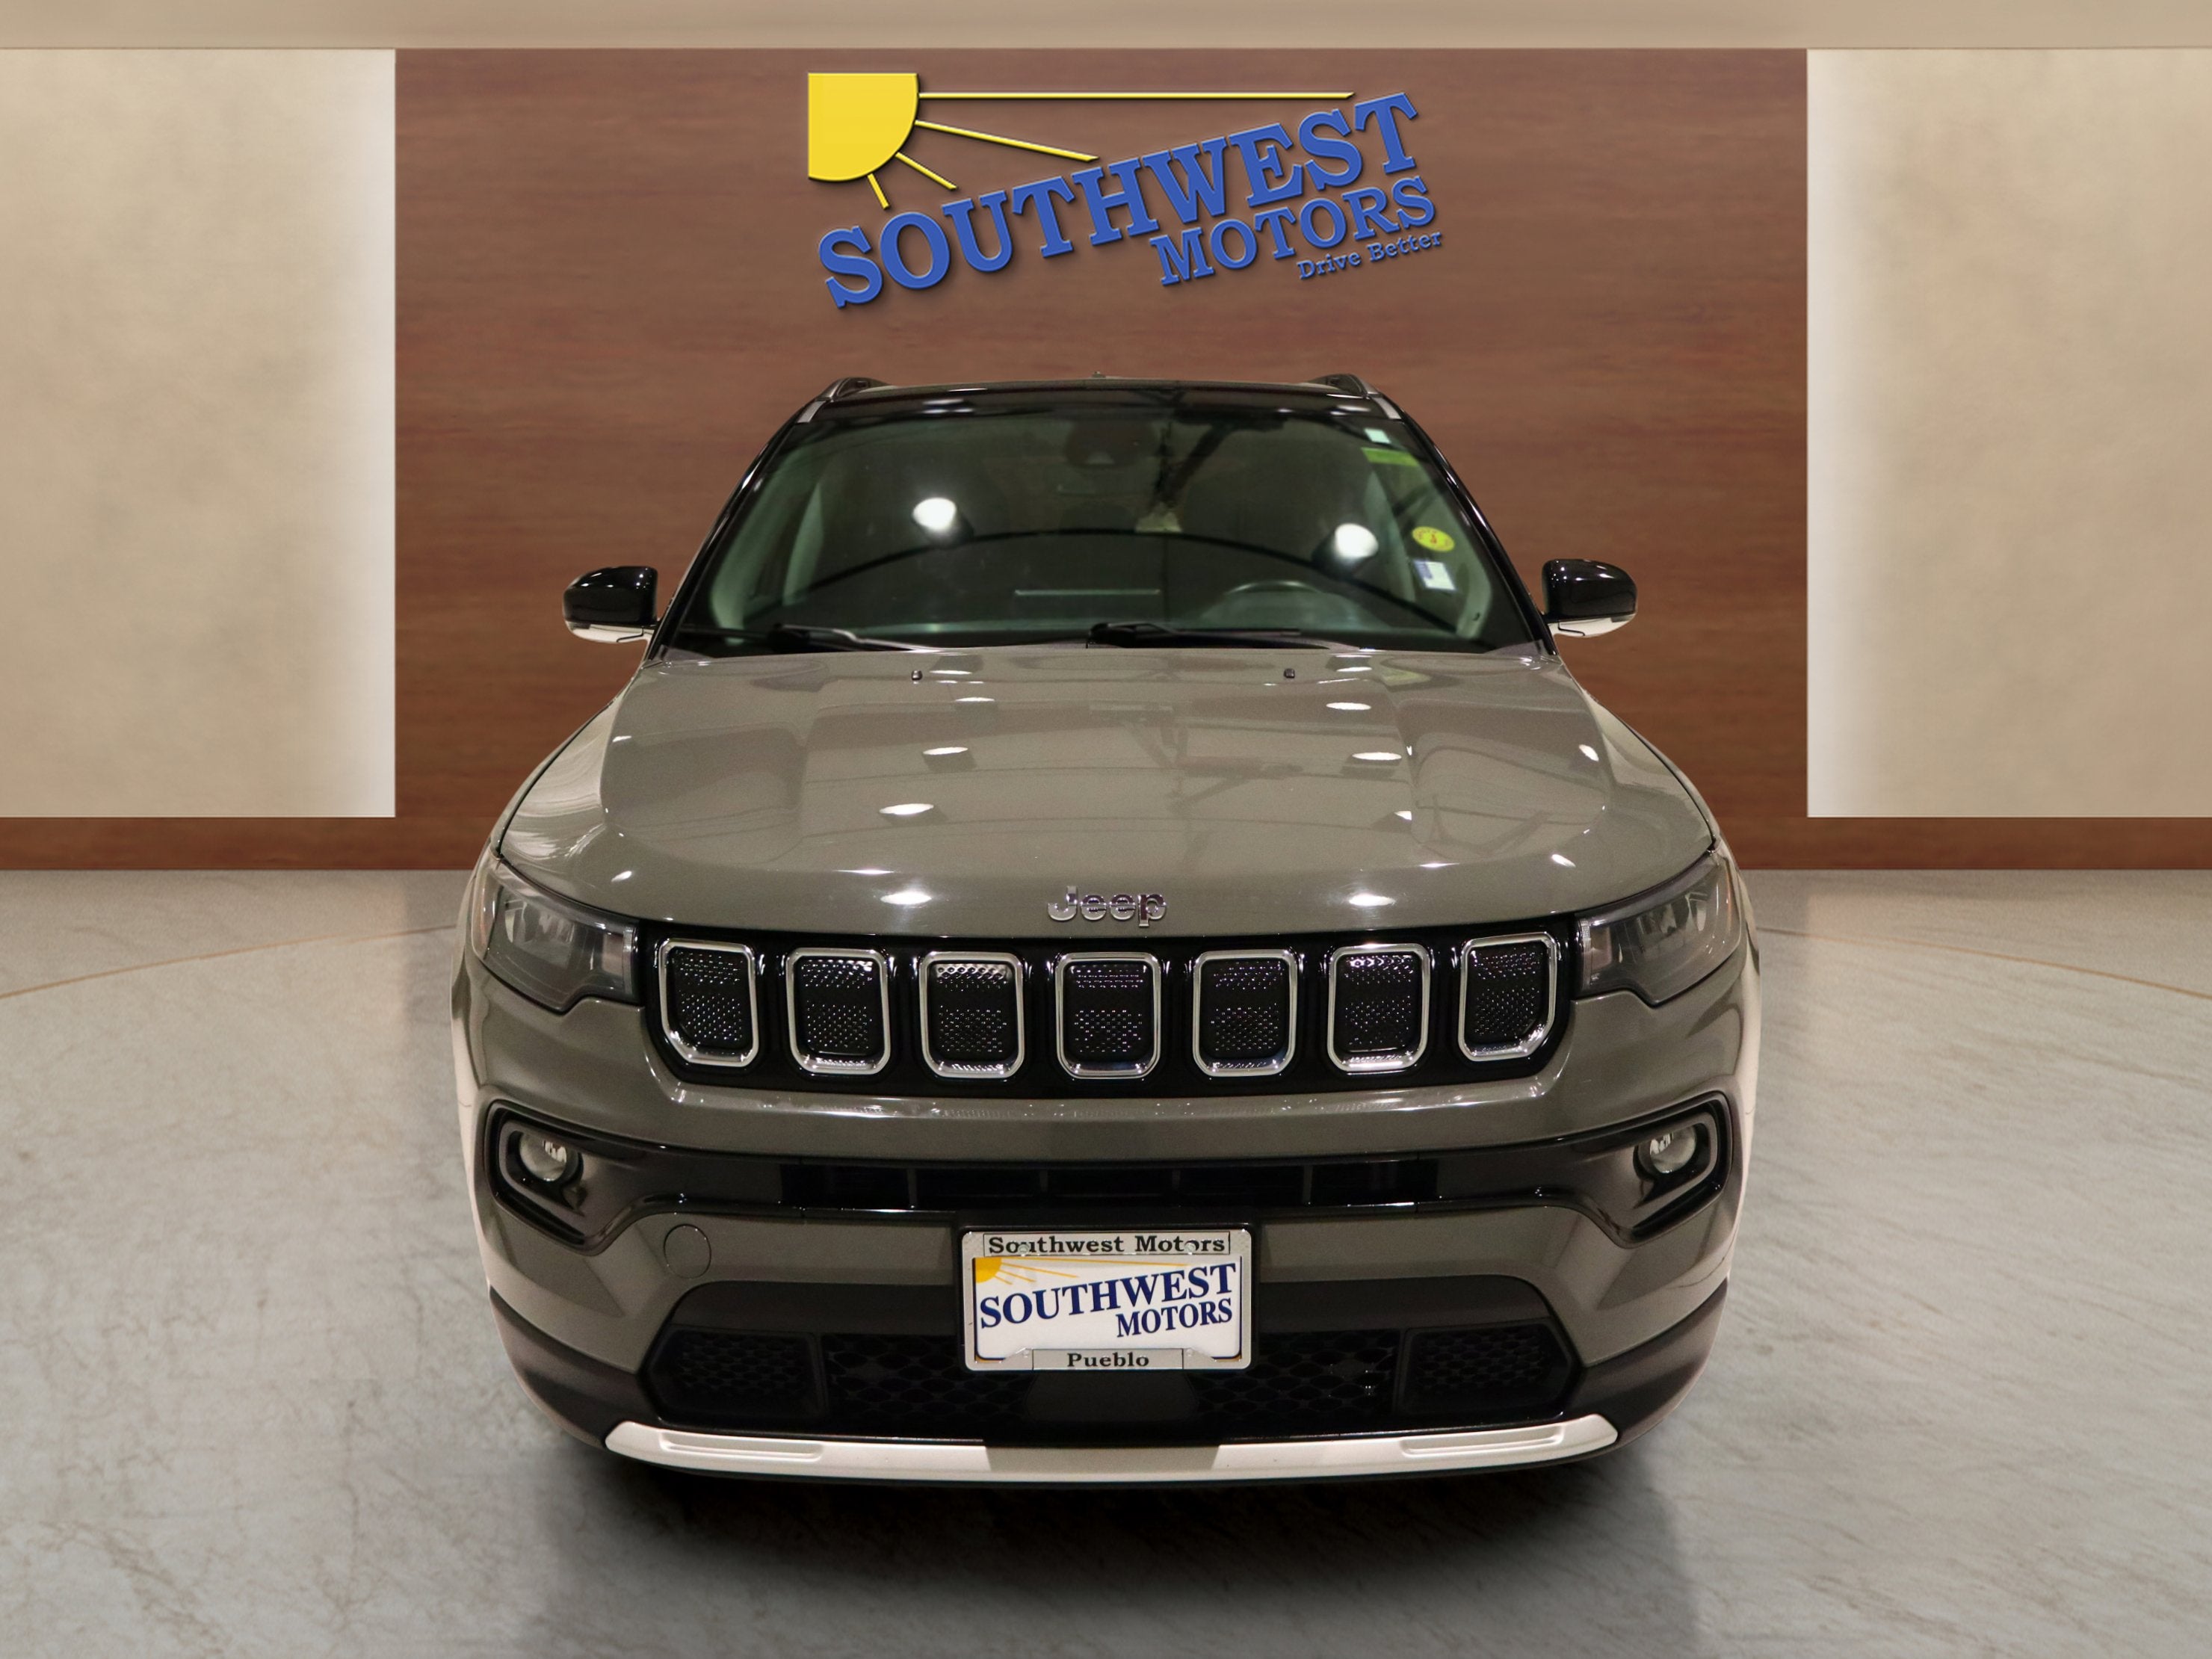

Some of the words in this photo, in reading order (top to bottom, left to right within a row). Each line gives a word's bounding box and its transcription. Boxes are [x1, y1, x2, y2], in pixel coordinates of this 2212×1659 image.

[818, 92, 1418, 308] SOUTHWEST
[1149, 176, 1436, 285] MOTORS
[1297, 251, 1362, 279] Drive
[1367, 231, 1442, 262] Better
[1048, 885, 1167, 927] Jeep
[980, 1263, 1236, 1329] SOUTHWEST
[1116, 1297, 1233, 1338] MOTORS
[1067, 1351, 1149, 1368] Pueblo
